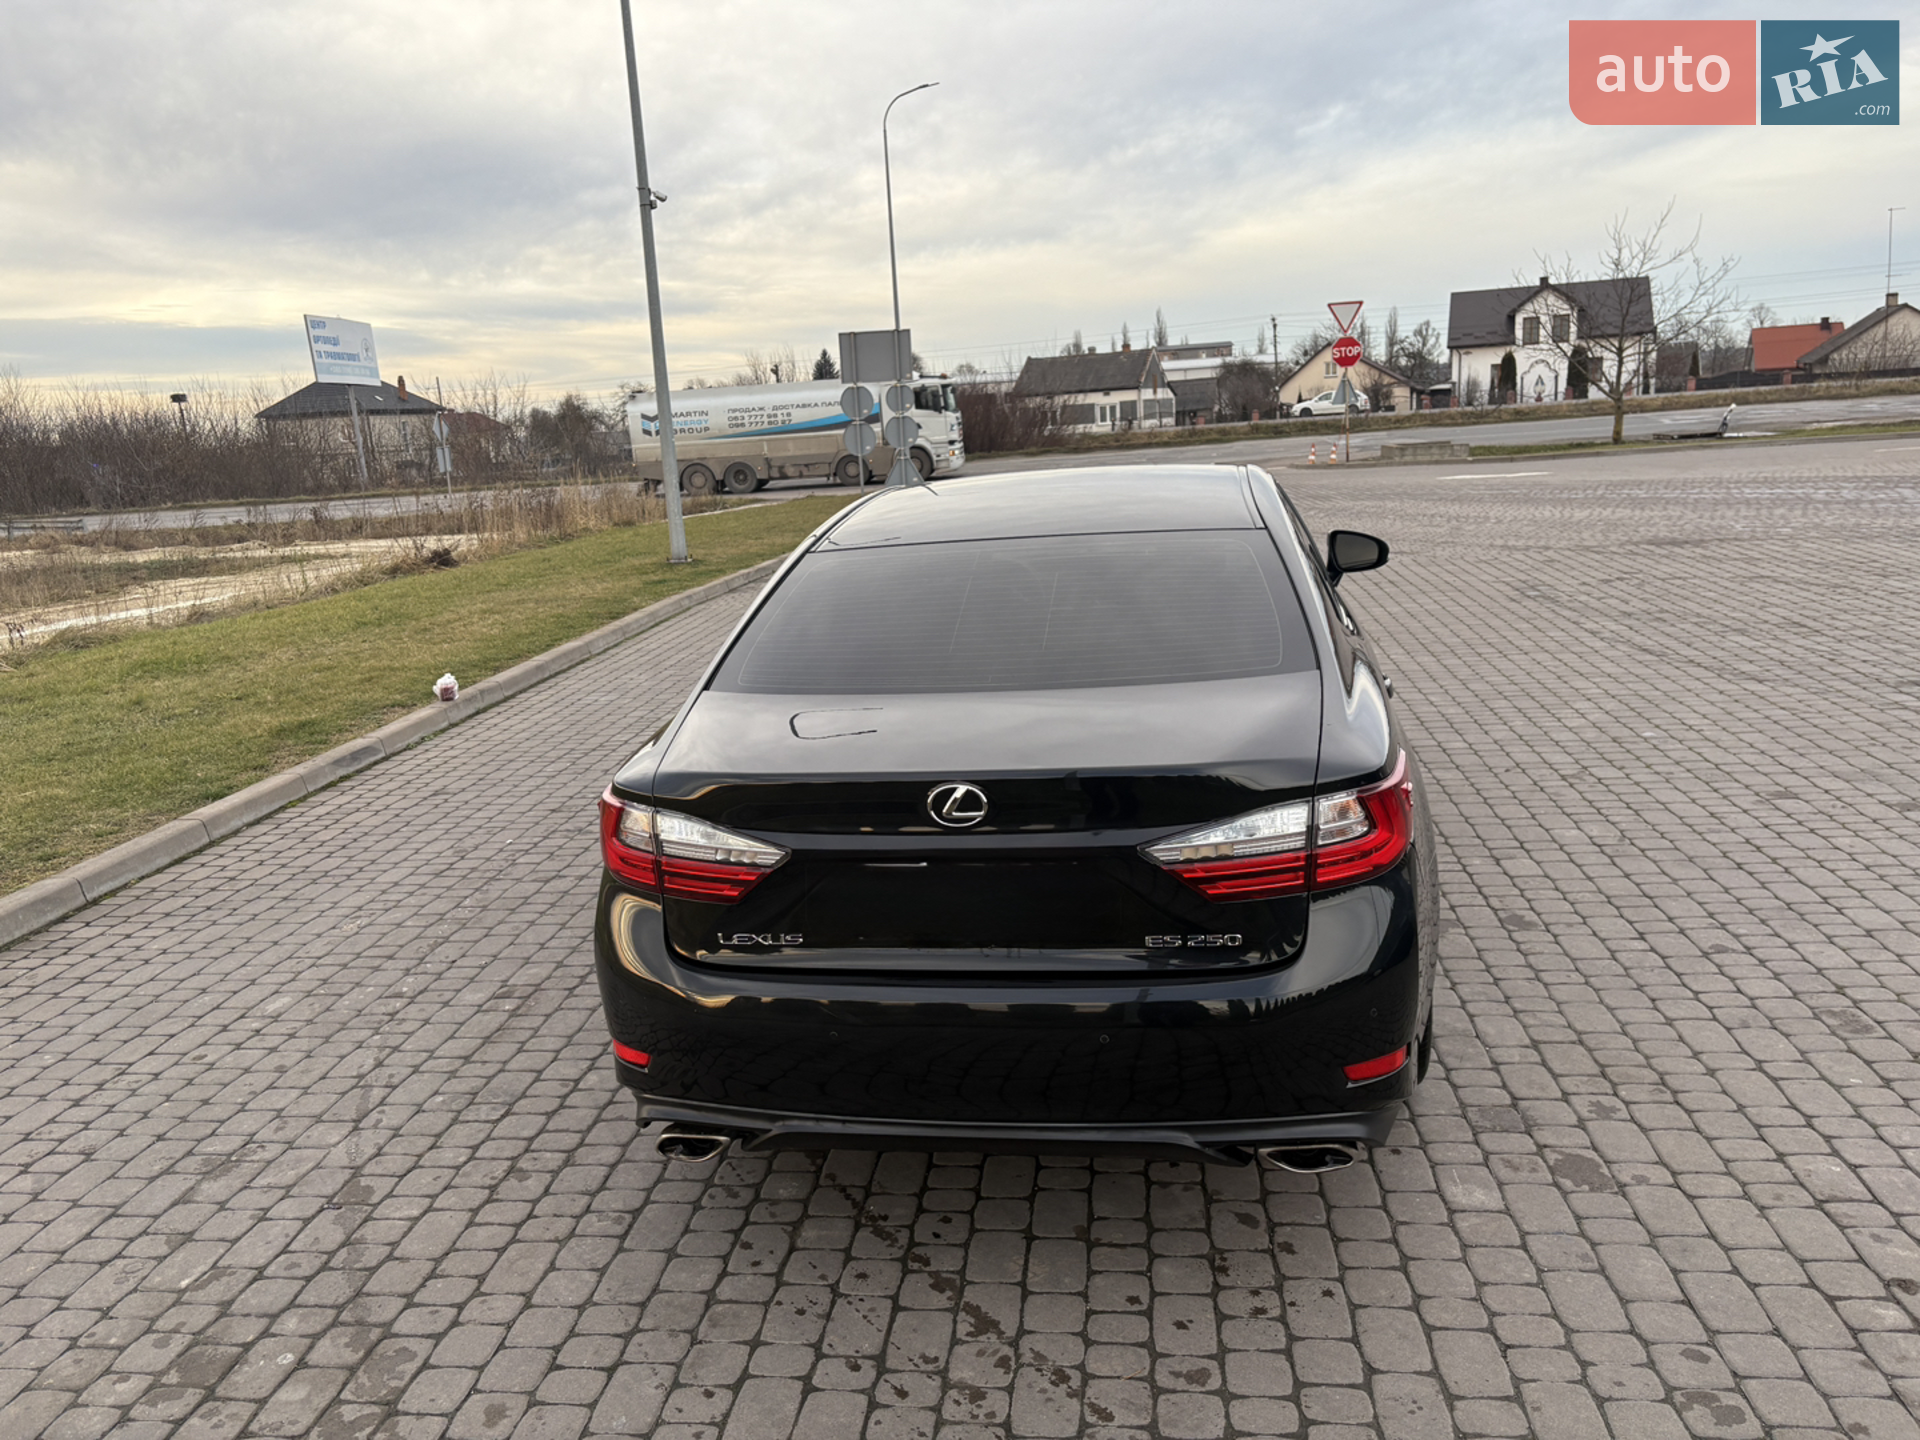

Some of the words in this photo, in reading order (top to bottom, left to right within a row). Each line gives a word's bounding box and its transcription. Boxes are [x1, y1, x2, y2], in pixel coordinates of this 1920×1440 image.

[1333, 345, 1361, 358] STOP
[727, 406, 766, 414] ПРОДАЖ
[772, 402, 819, 412] ДОСТАВКА
[820, 400, 841, 408] ПАЛ
[671, 410, 709, 419] MARTIN
[747, 413, 765, 421] 777
[747, 420, 765, 428] 777
[717, 932, 804, 946] LEXUS
[1145, 934, 1182, 948] ES
[1187, 933, 1243, 948] 250
